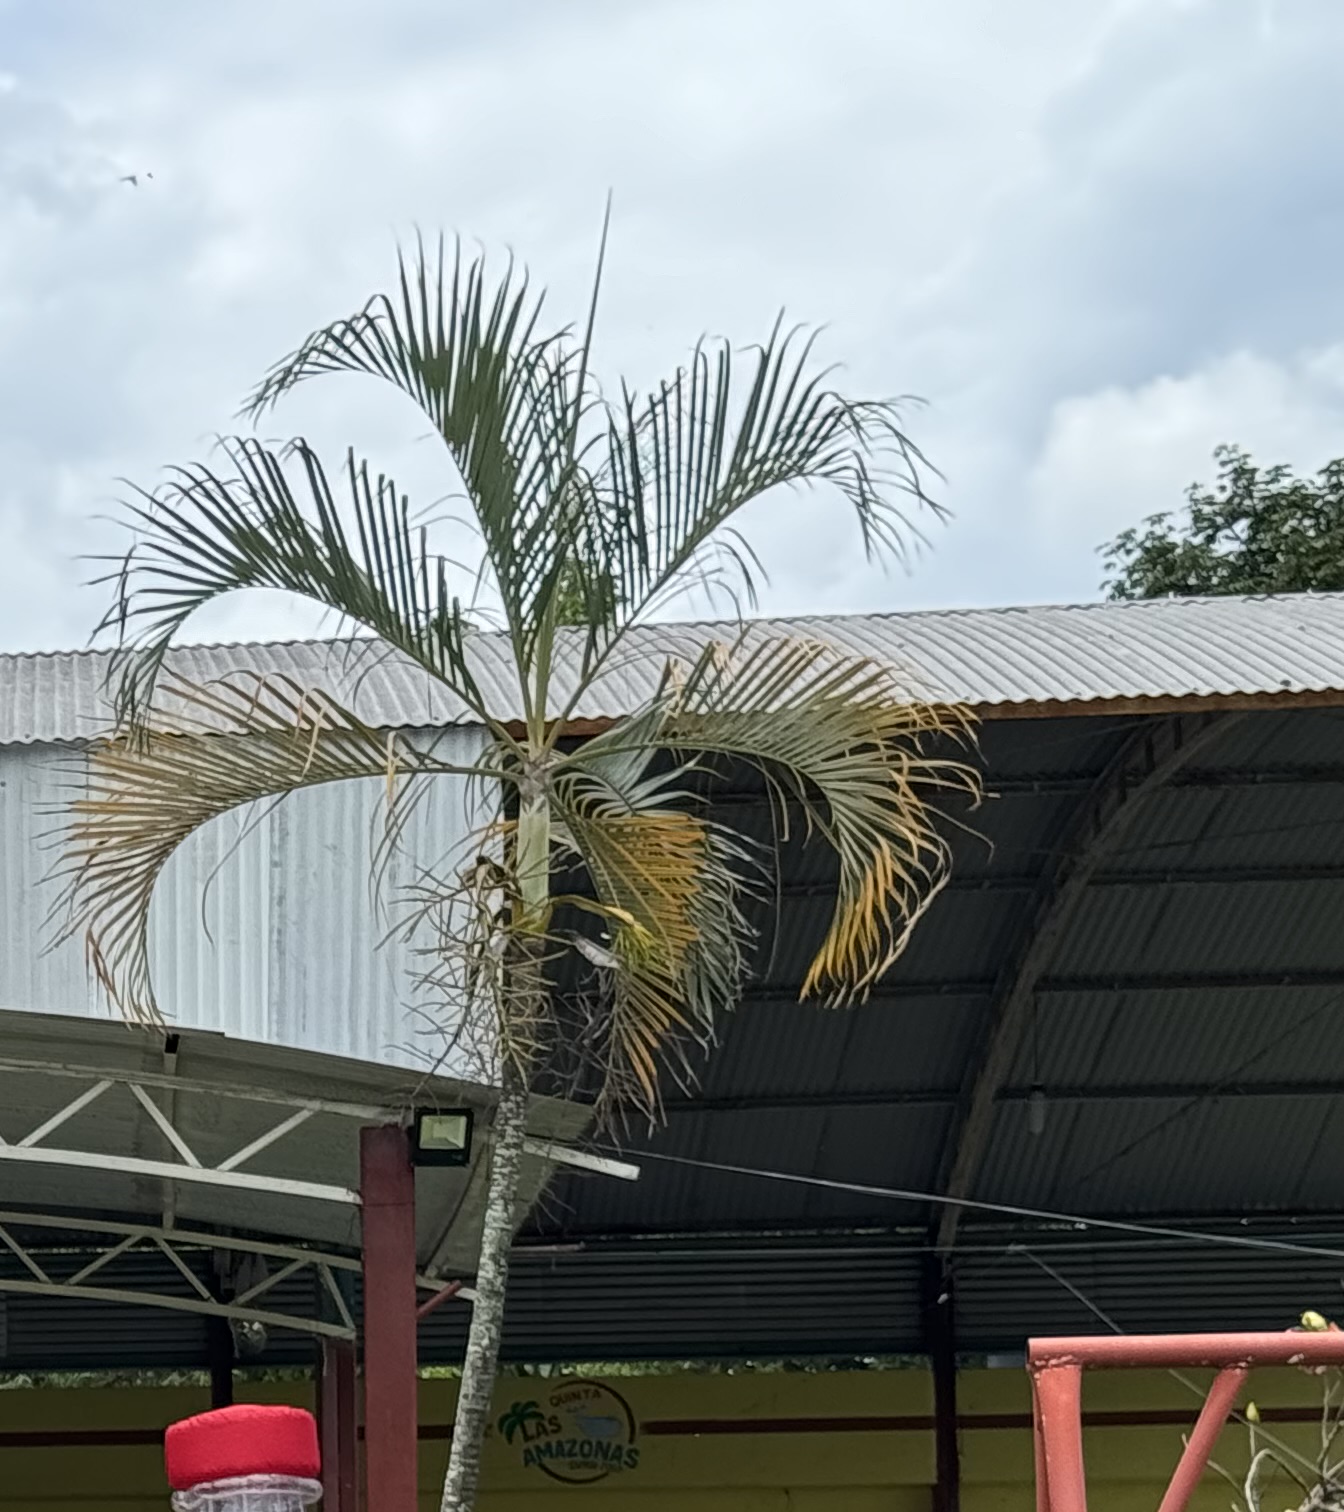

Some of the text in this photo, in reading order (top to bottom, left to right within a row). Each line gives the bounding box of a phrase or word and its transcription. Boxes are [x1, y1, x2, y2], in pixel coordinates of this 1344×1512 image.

[549, 1388, 602, 1408] QUINTA
[520, 1414, 562, 1443] LAS
[522, 1437, 640, 1469] AMAZONAS
